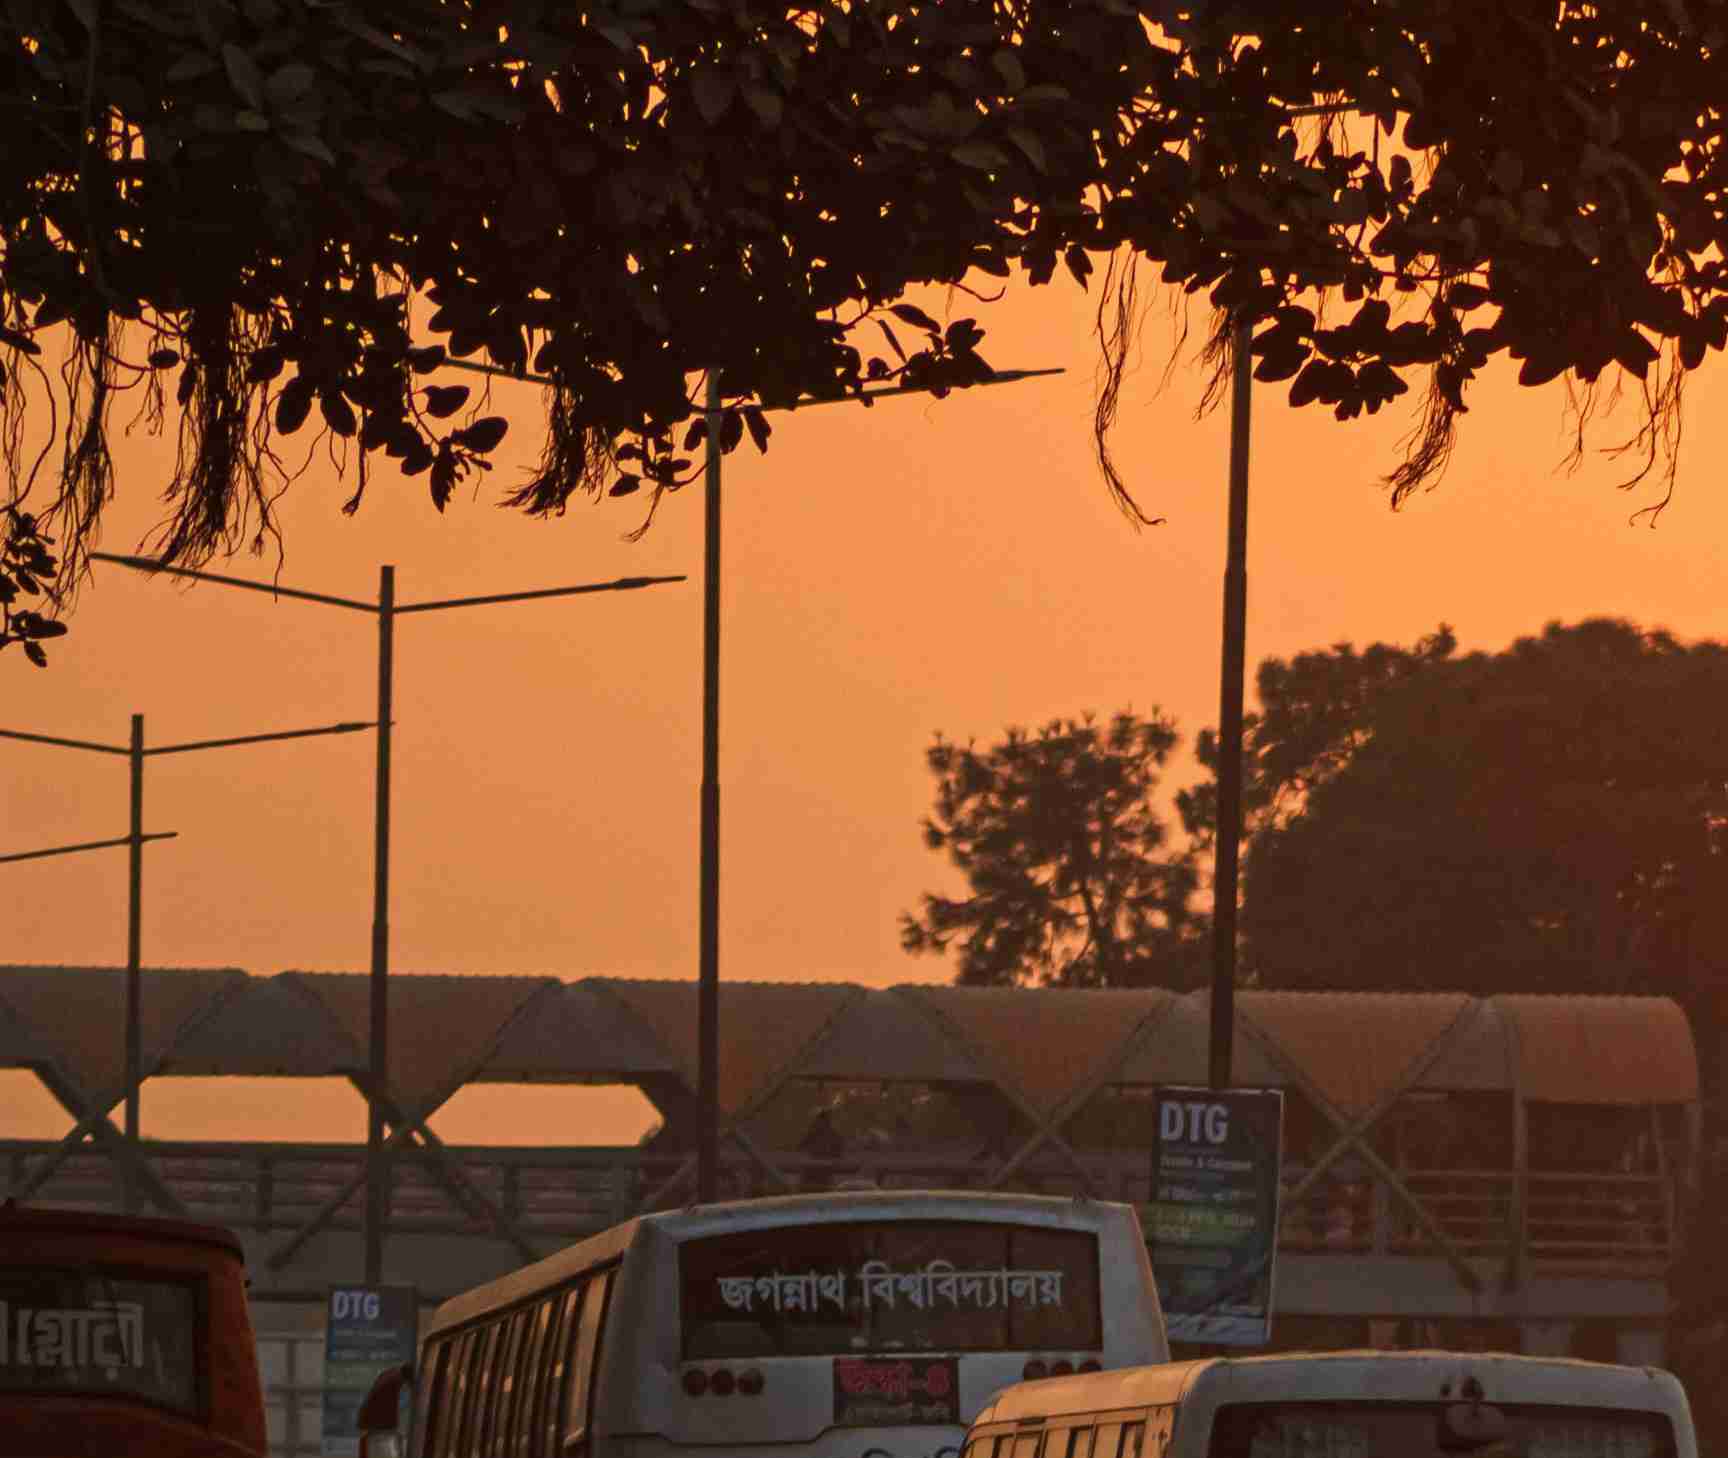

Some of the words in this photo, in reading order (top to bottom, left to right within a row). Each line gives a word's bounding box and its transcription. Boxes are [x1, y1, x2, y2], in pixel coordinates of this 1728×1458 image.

[1159, 1100, 1230, 1144] DTG
[332, 1290, 380, 1321] DTG
[717, 1270, 846, 1312] জগন্নাথ
[857, 1259, 1063, 1309] বিশ্ববিদ্যালয়
